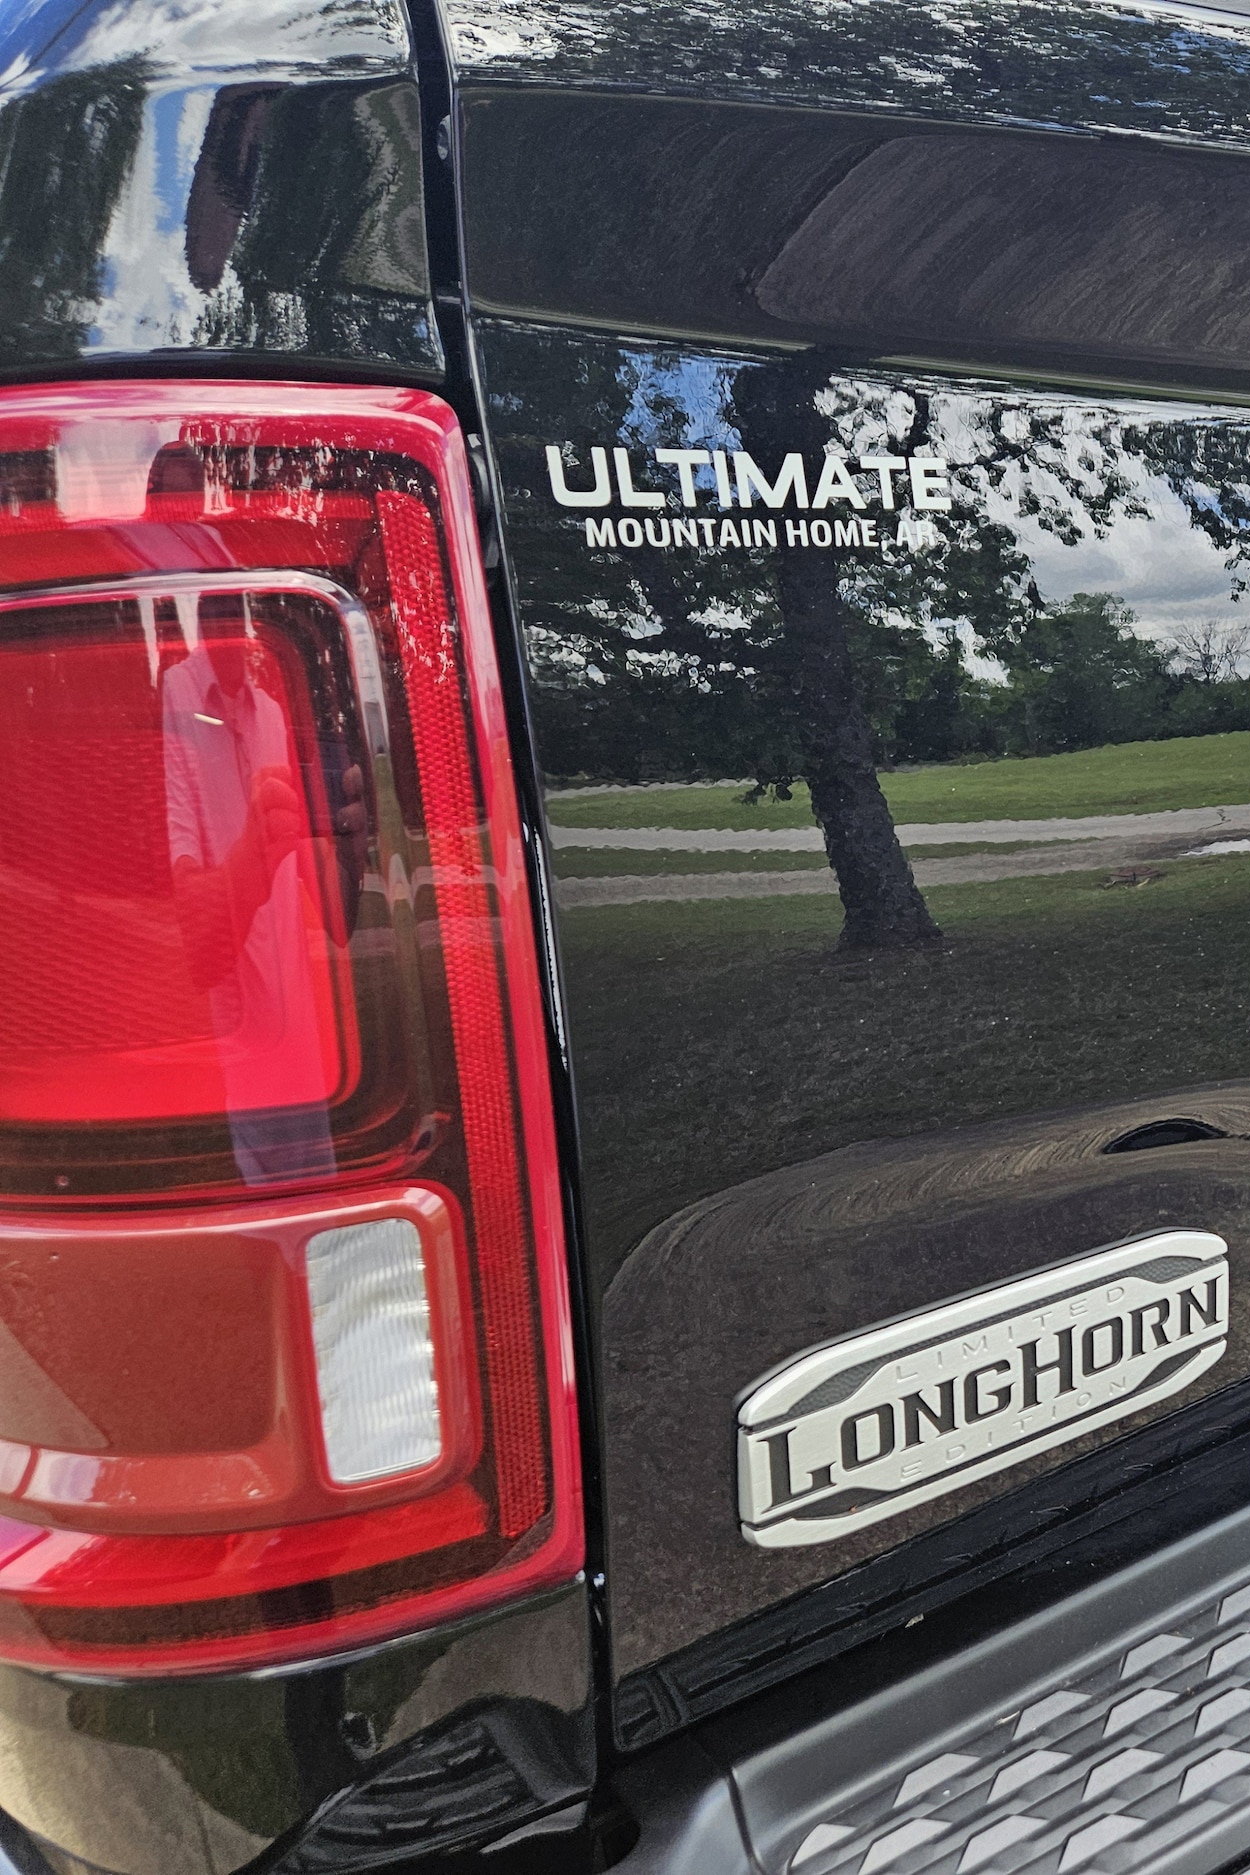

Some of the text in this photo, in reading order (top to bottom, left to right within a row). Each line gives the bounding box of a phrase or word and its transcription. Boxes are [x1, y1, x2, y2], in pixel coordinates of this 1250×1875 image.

[545, 445, 952, 510] ULTIMATE
[585, 517, 935, 551] MOUNTAIN HOME, AR
[896, 1286, 1125, 1383] LIMITED
[901, 1376, 1127, 1481] EDITION
